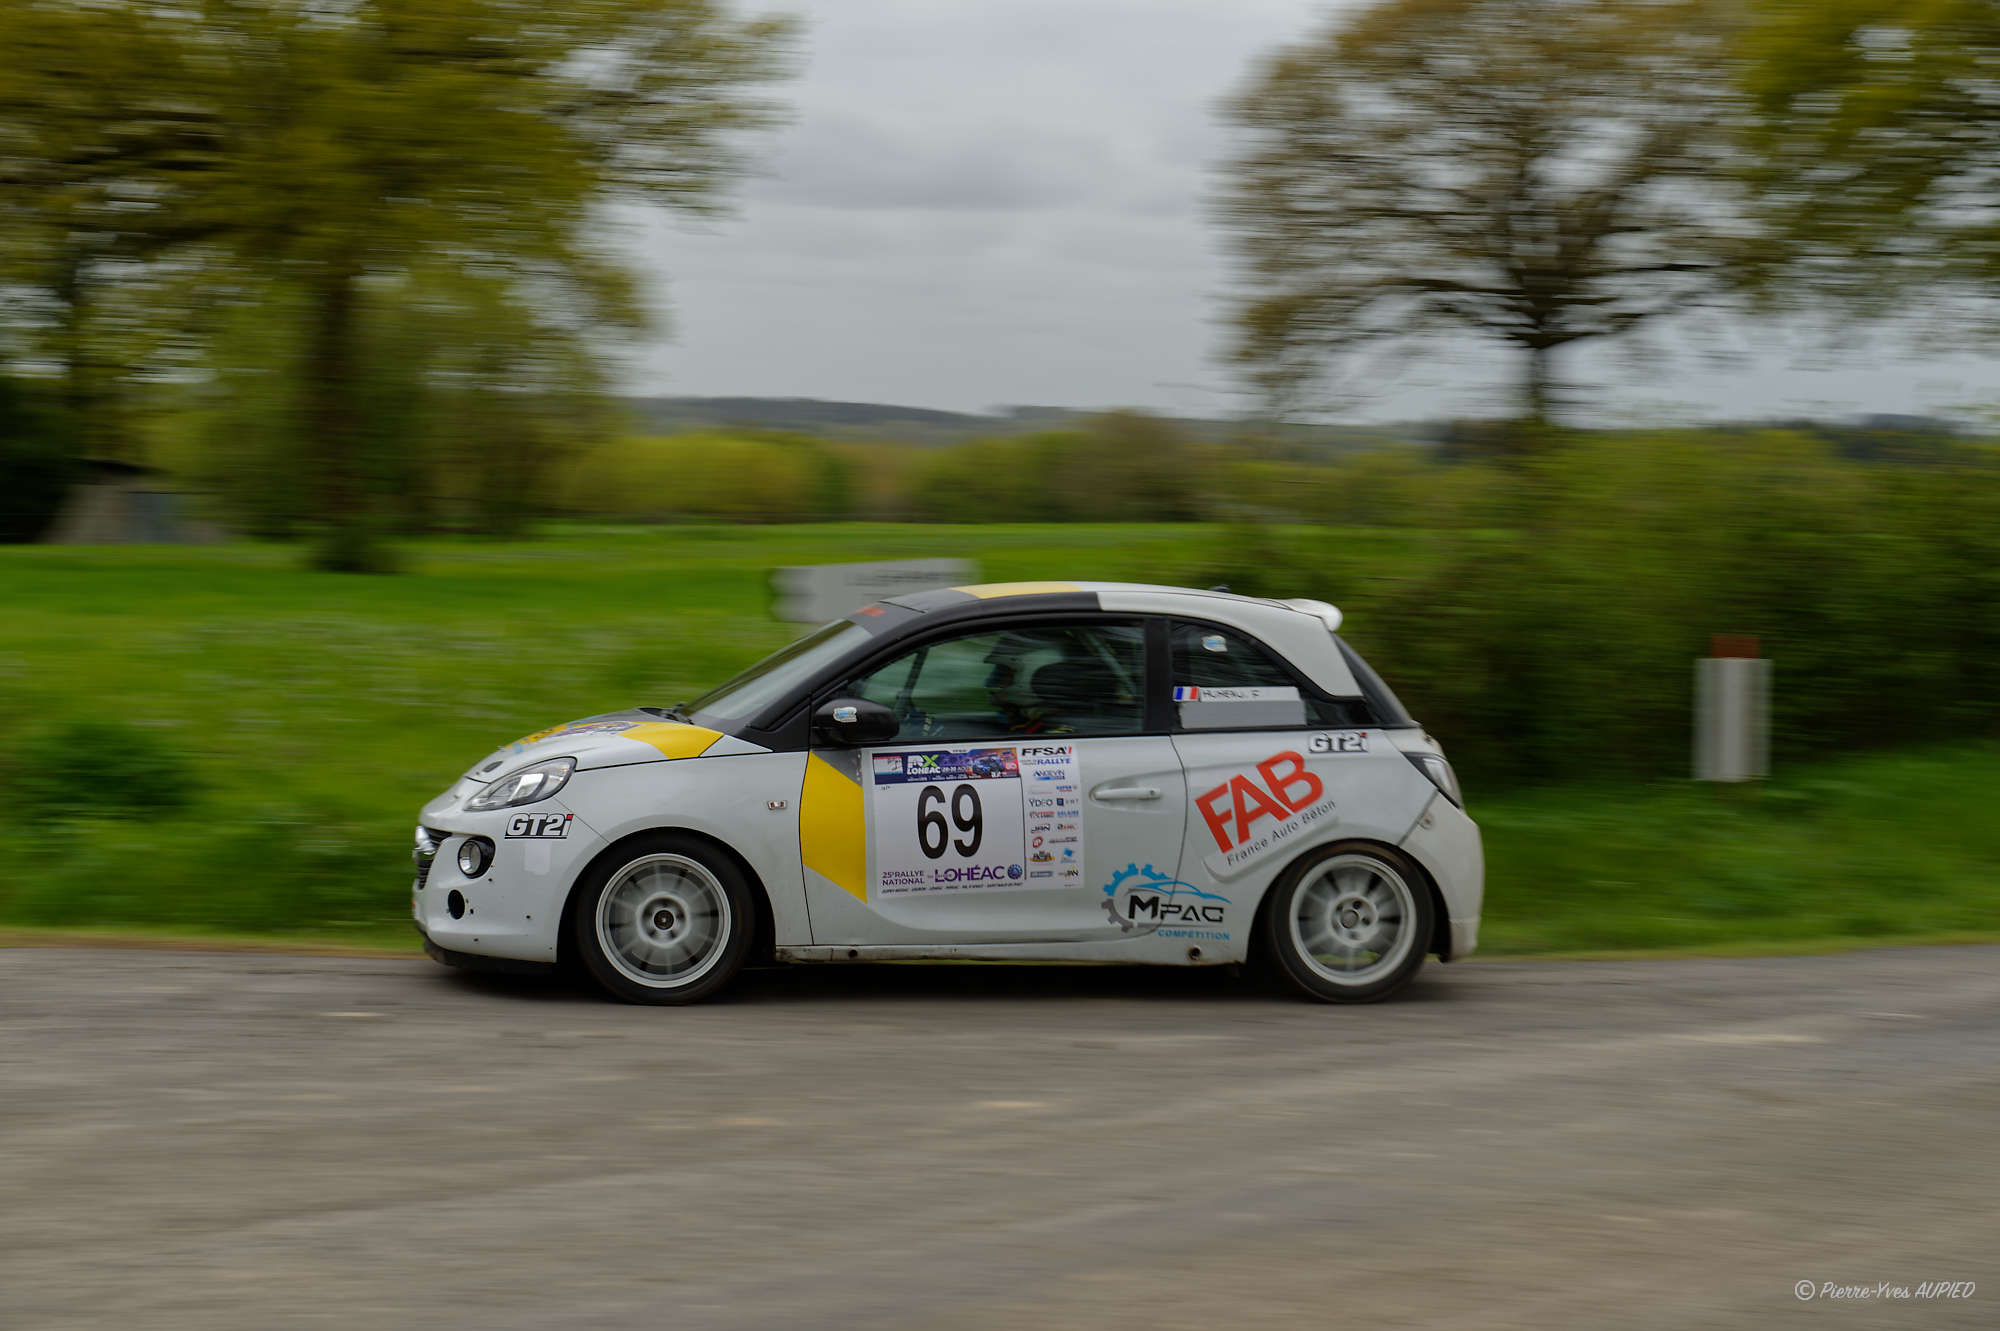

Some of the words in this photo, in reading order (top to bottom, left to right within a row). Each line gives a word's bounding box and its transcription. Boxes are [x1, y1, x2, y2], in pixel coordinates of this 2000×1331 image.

[1309, 732, 1368, 753] GT2i
[1037, 758, 1071, 766] RALLYE
[1194, 750, 1324, 854] FAB
[506, 813, 573, 837] GT2i
[917, 784, 983, 859] 69
[1226, 839, 1269, 866] France
[1271, 821, 1300, 842] Auto
[882, 876, 926, 887] NATIONAL
[894, 869, 925, 878] RALLYE
[934, 865, 1006, 883] LOHÉAC
